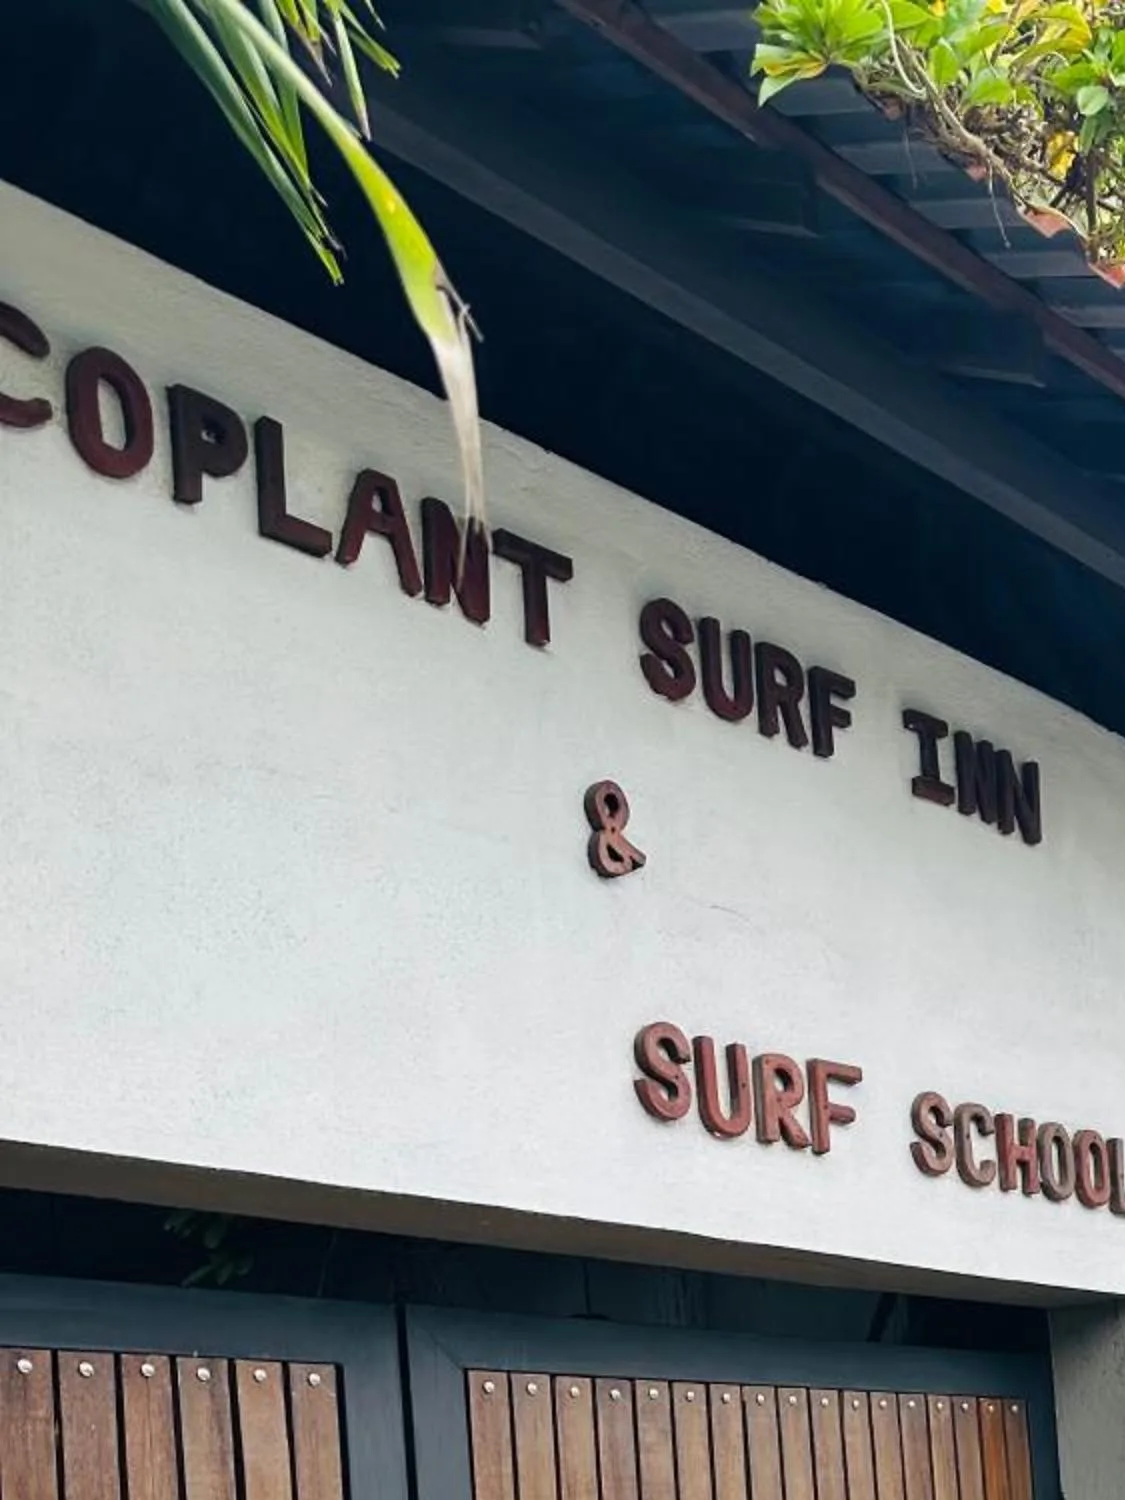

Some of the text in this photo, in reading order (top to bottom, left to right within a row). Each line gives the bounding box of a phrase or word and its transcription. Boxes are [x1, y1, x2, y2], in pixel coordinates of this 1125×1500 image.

[639, 597, 857, 759] SURF
[902, 708, 1043, 847] INN
[583, 779, 647, 878] &
[633, 1021, 863, 1154] SURF
